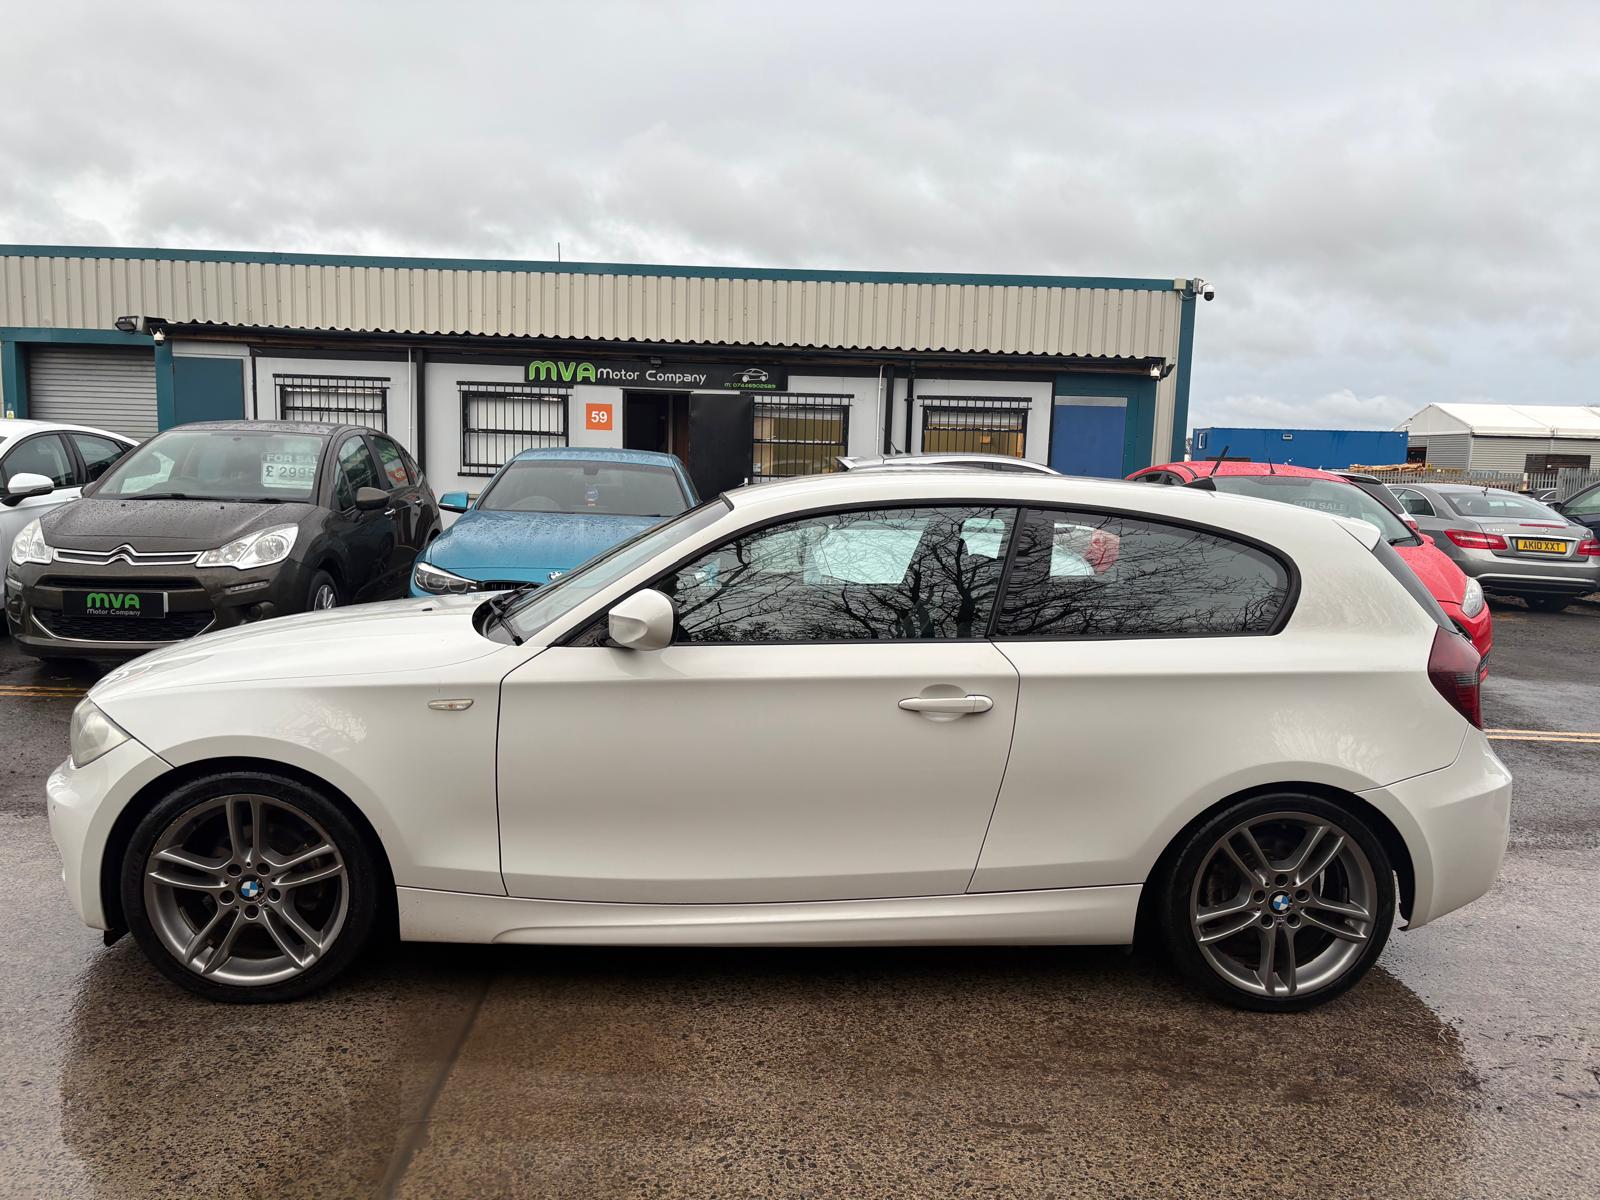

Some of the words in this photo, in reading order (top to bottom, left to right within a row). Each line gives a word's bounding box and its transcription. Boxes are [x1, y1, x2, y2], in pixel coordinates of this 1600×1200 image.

[529, 360, 596, 382] MVA
[597, 368, 640, 381] Motor
[645, 370, 707, 384] Company
[591, 411, 608, 423] 59
[266, 453, 293, 463] FOR
[296, 455, 318, 465] SAL
[1318, 502, 1345, 511] SALE
[1523, 540, 1542, 550] AK10
[1544, 541, 1561, 551] XXT
[87, 592, 140, 608] MVA
